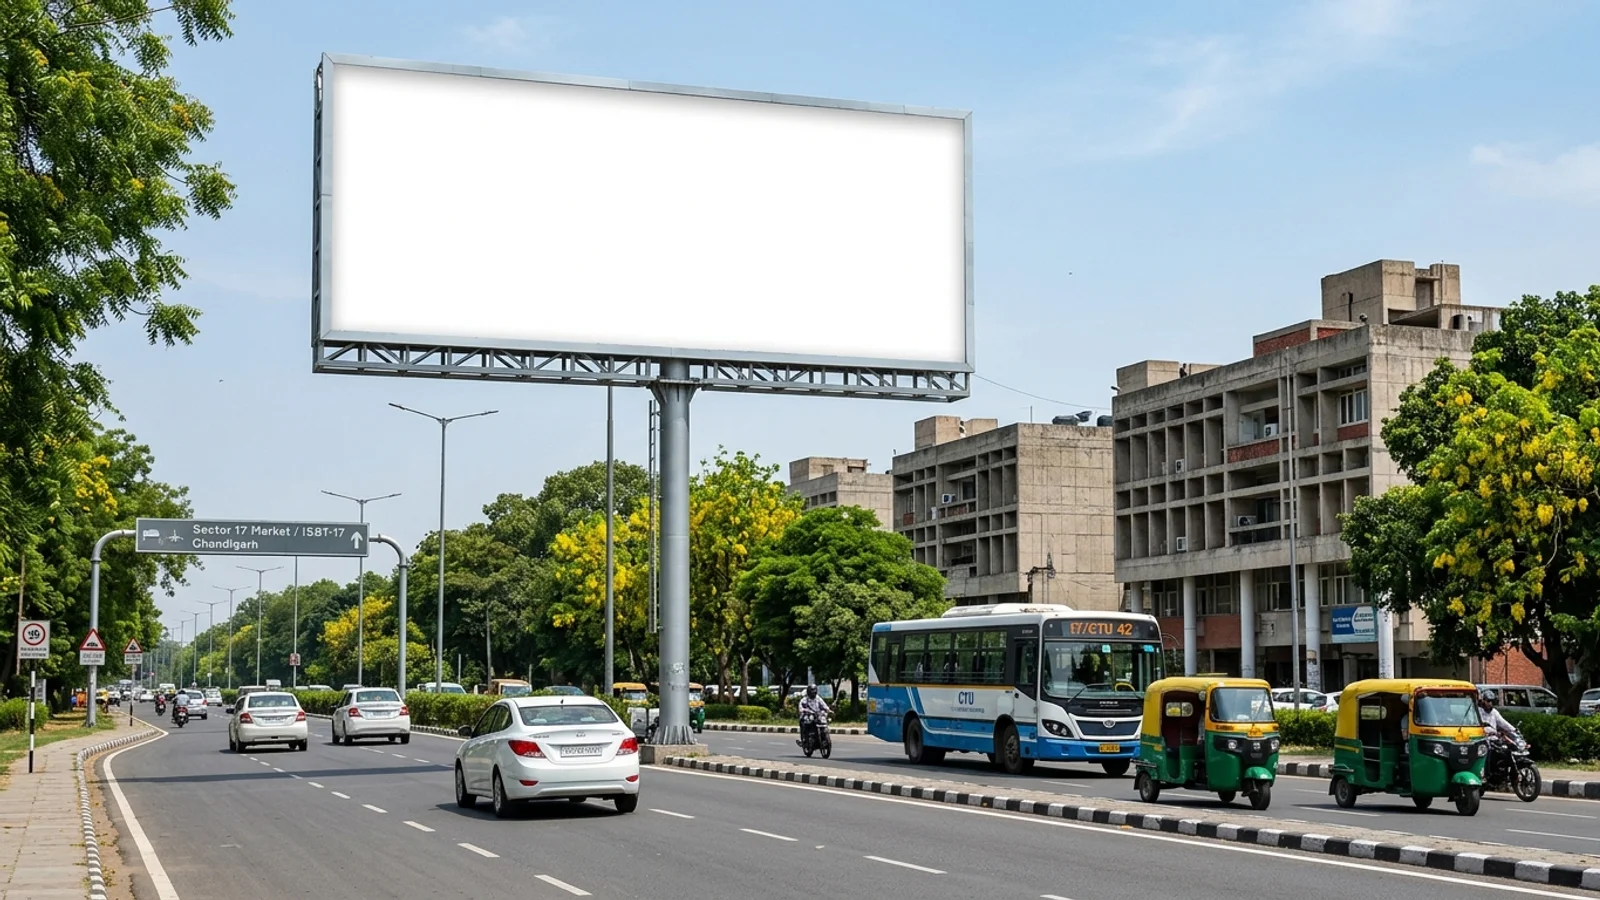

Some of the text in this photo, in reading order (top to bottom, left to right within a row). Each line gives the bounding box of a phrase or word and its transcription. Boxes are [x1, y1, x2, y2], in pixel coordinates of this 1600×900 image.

[193, 524, 231, 535] Sector
[235, 525, 248, 535] 17
[251, 525, 290, 536] Market
[192, 538, 259, 551] Chandigarh
[1117, 623, 1133, 636] 42
[958, 691, 974, 706] CTU
